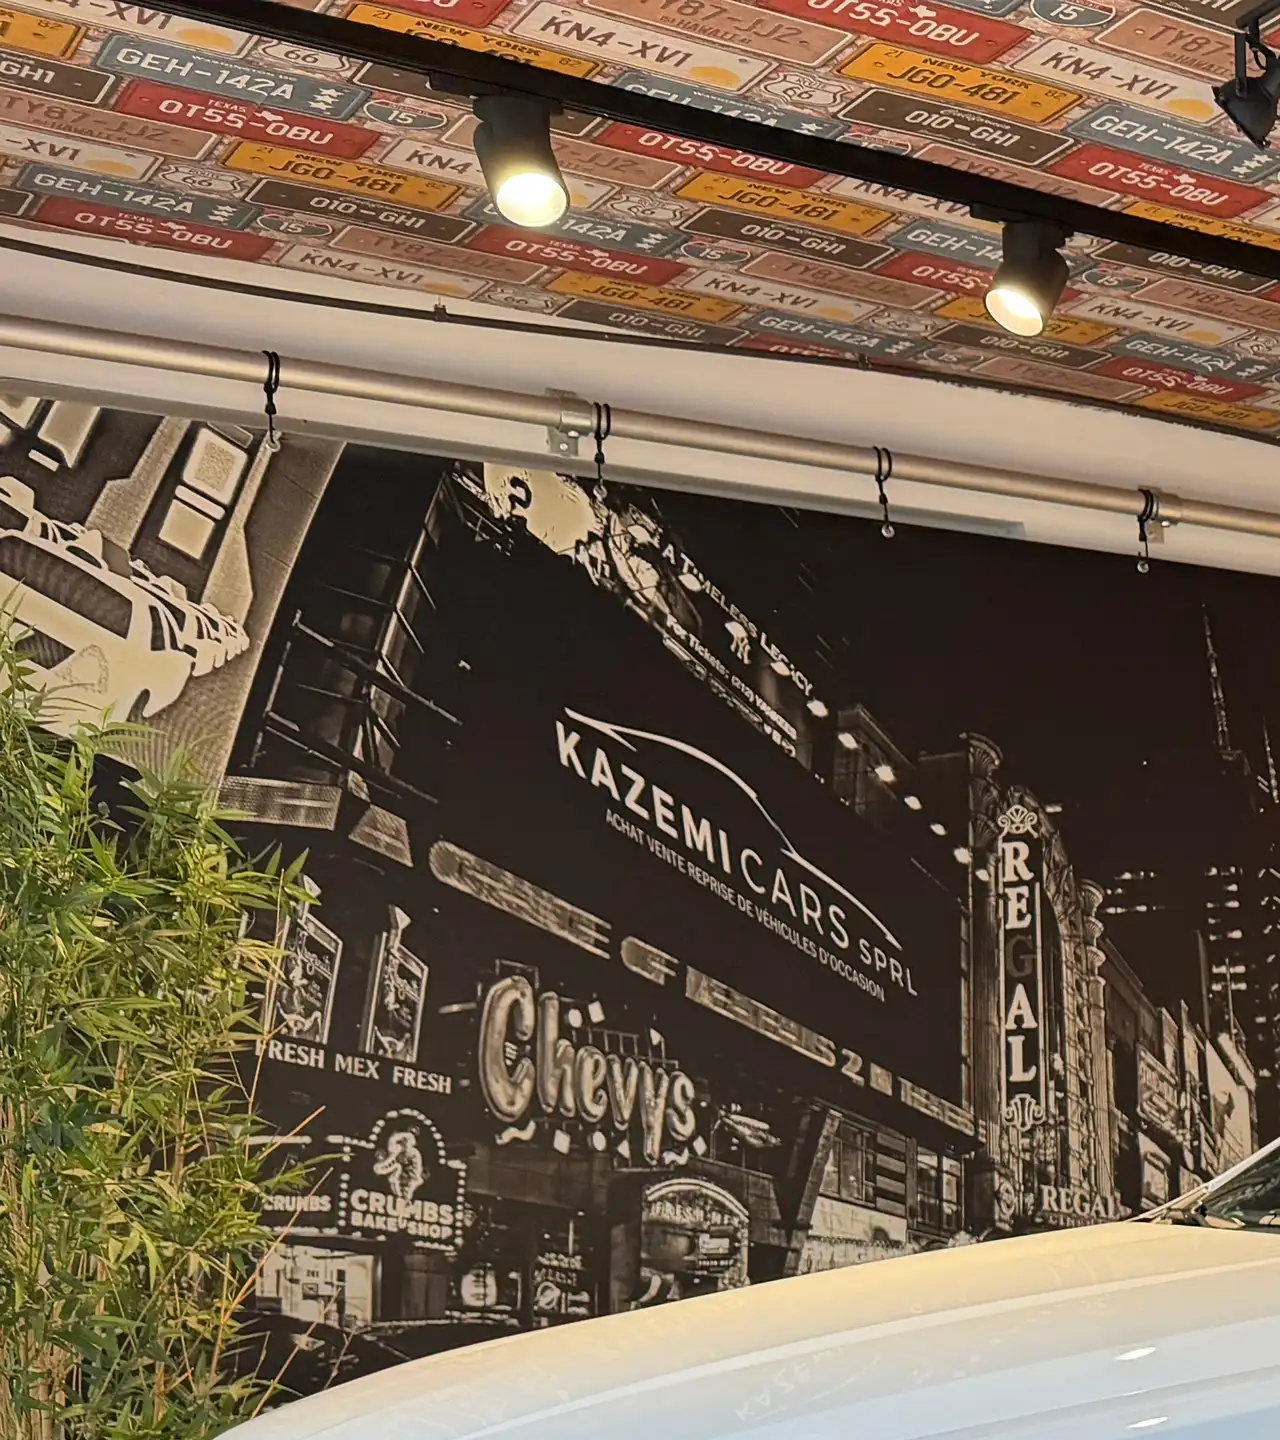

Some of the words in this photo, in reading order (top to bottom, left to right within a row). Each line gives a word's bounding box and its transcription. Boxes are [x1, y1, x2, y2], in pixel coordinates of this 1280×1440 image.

[116, 48, 296, 100] GEH-142A
[1090, 115, 1233, 165] GEH-142A
[33, 173, 192, 215] GEH-142A
[758, 316, 879, 349] GEH-142A
[555, 719, 732, 874] KAZEMI
[739, 848, 850, 949] CARS
[859, 938, 918, 997] SPRL
[606, 808, 645, 846] ACHAT
[646, 836, 686, 873] VENTE
[687, 860, 736, 907] REPRISE
[737, 894, 754, 918] DE
[755, 903, 817, 958] VÉHICULES
[818, 947, 886, 1003] D'OCCASION
[1003, 841, 1037, 1082] REGAL
[334, 1053, 380, 1080] MEX
[392, 1066, 452, 1094] FRESH
[478, 975, 696, 1165] Chevys
[351, 1188, 454, 1225] CRUMBS
